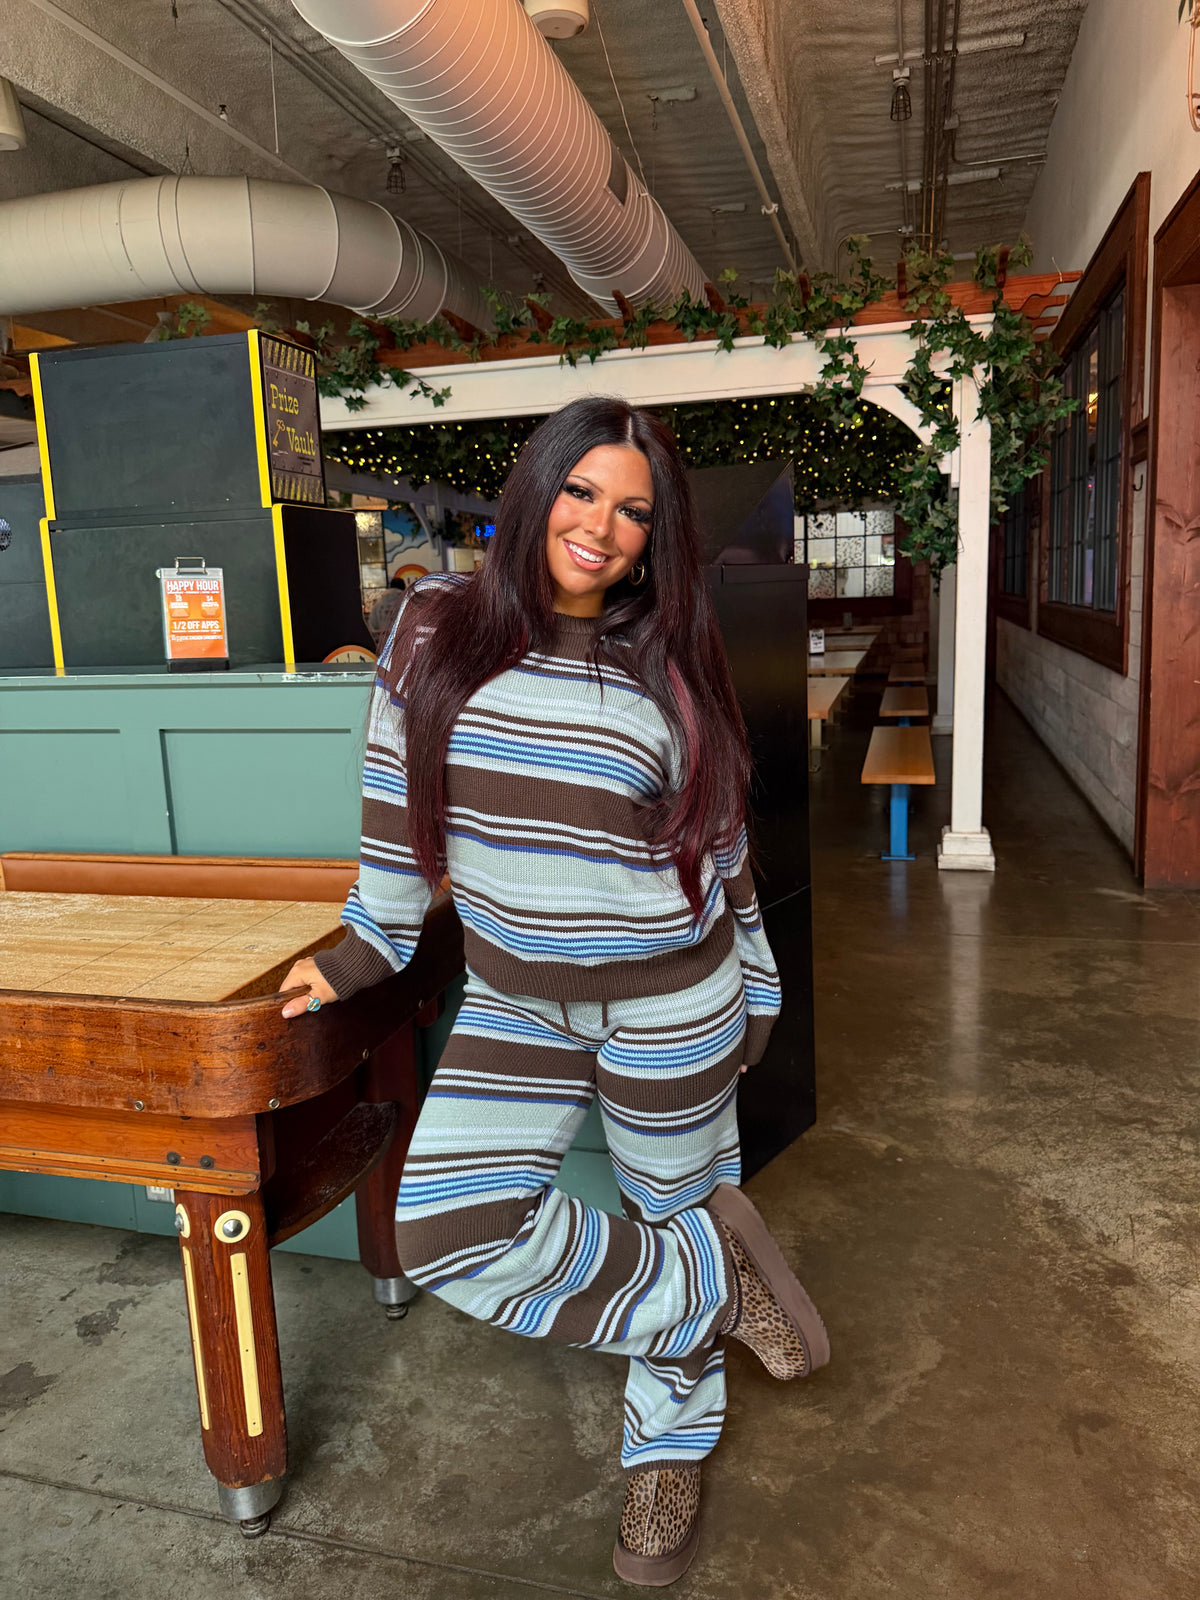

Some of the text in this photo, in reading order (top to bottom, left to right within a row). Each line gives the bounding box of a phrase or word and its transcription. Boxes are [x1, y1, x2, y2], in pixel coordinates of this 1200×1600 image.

[270, 384, 299, 415] Prize
[286, 427, 316, 456] Vault
[167, 580, 219, 591] HAPPY HOUR
[173, 620, 219, 630] 1/2 OFF APPS
